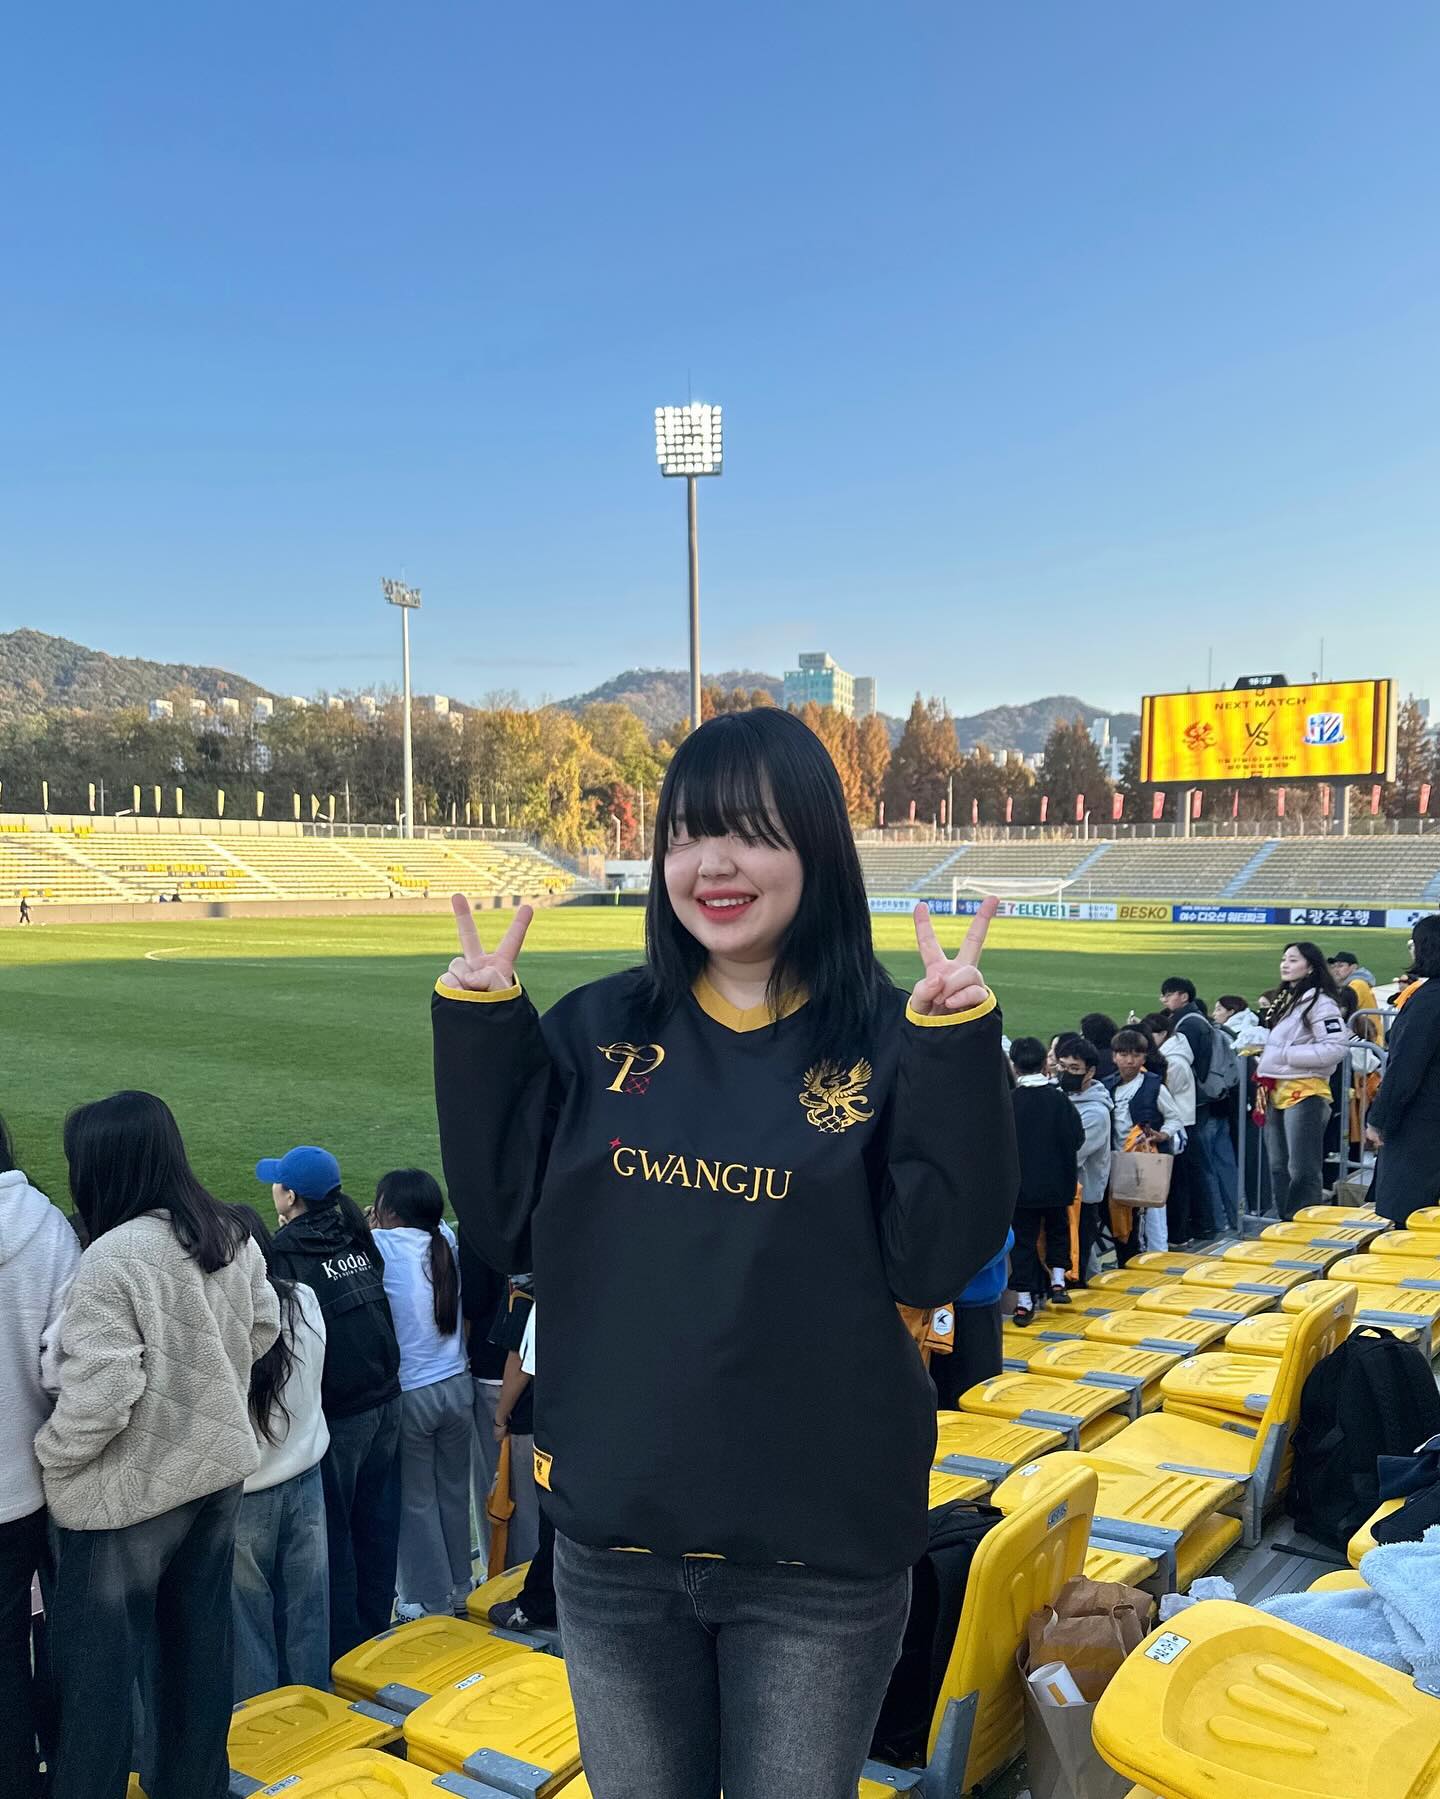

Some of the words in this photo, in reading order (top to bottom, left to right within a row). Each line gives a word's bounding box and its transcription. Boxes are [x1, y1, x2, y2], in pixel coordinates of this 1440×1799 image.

[1214, 701, 1249, 711] NEXT
[1255, 697, 1307, 707] MATCH
[1120, 906, 1168, 919] BESKO
[1308, 909, 1370, 925] 광주은행
[613, 1147, 793, 1202] GWANGJU
